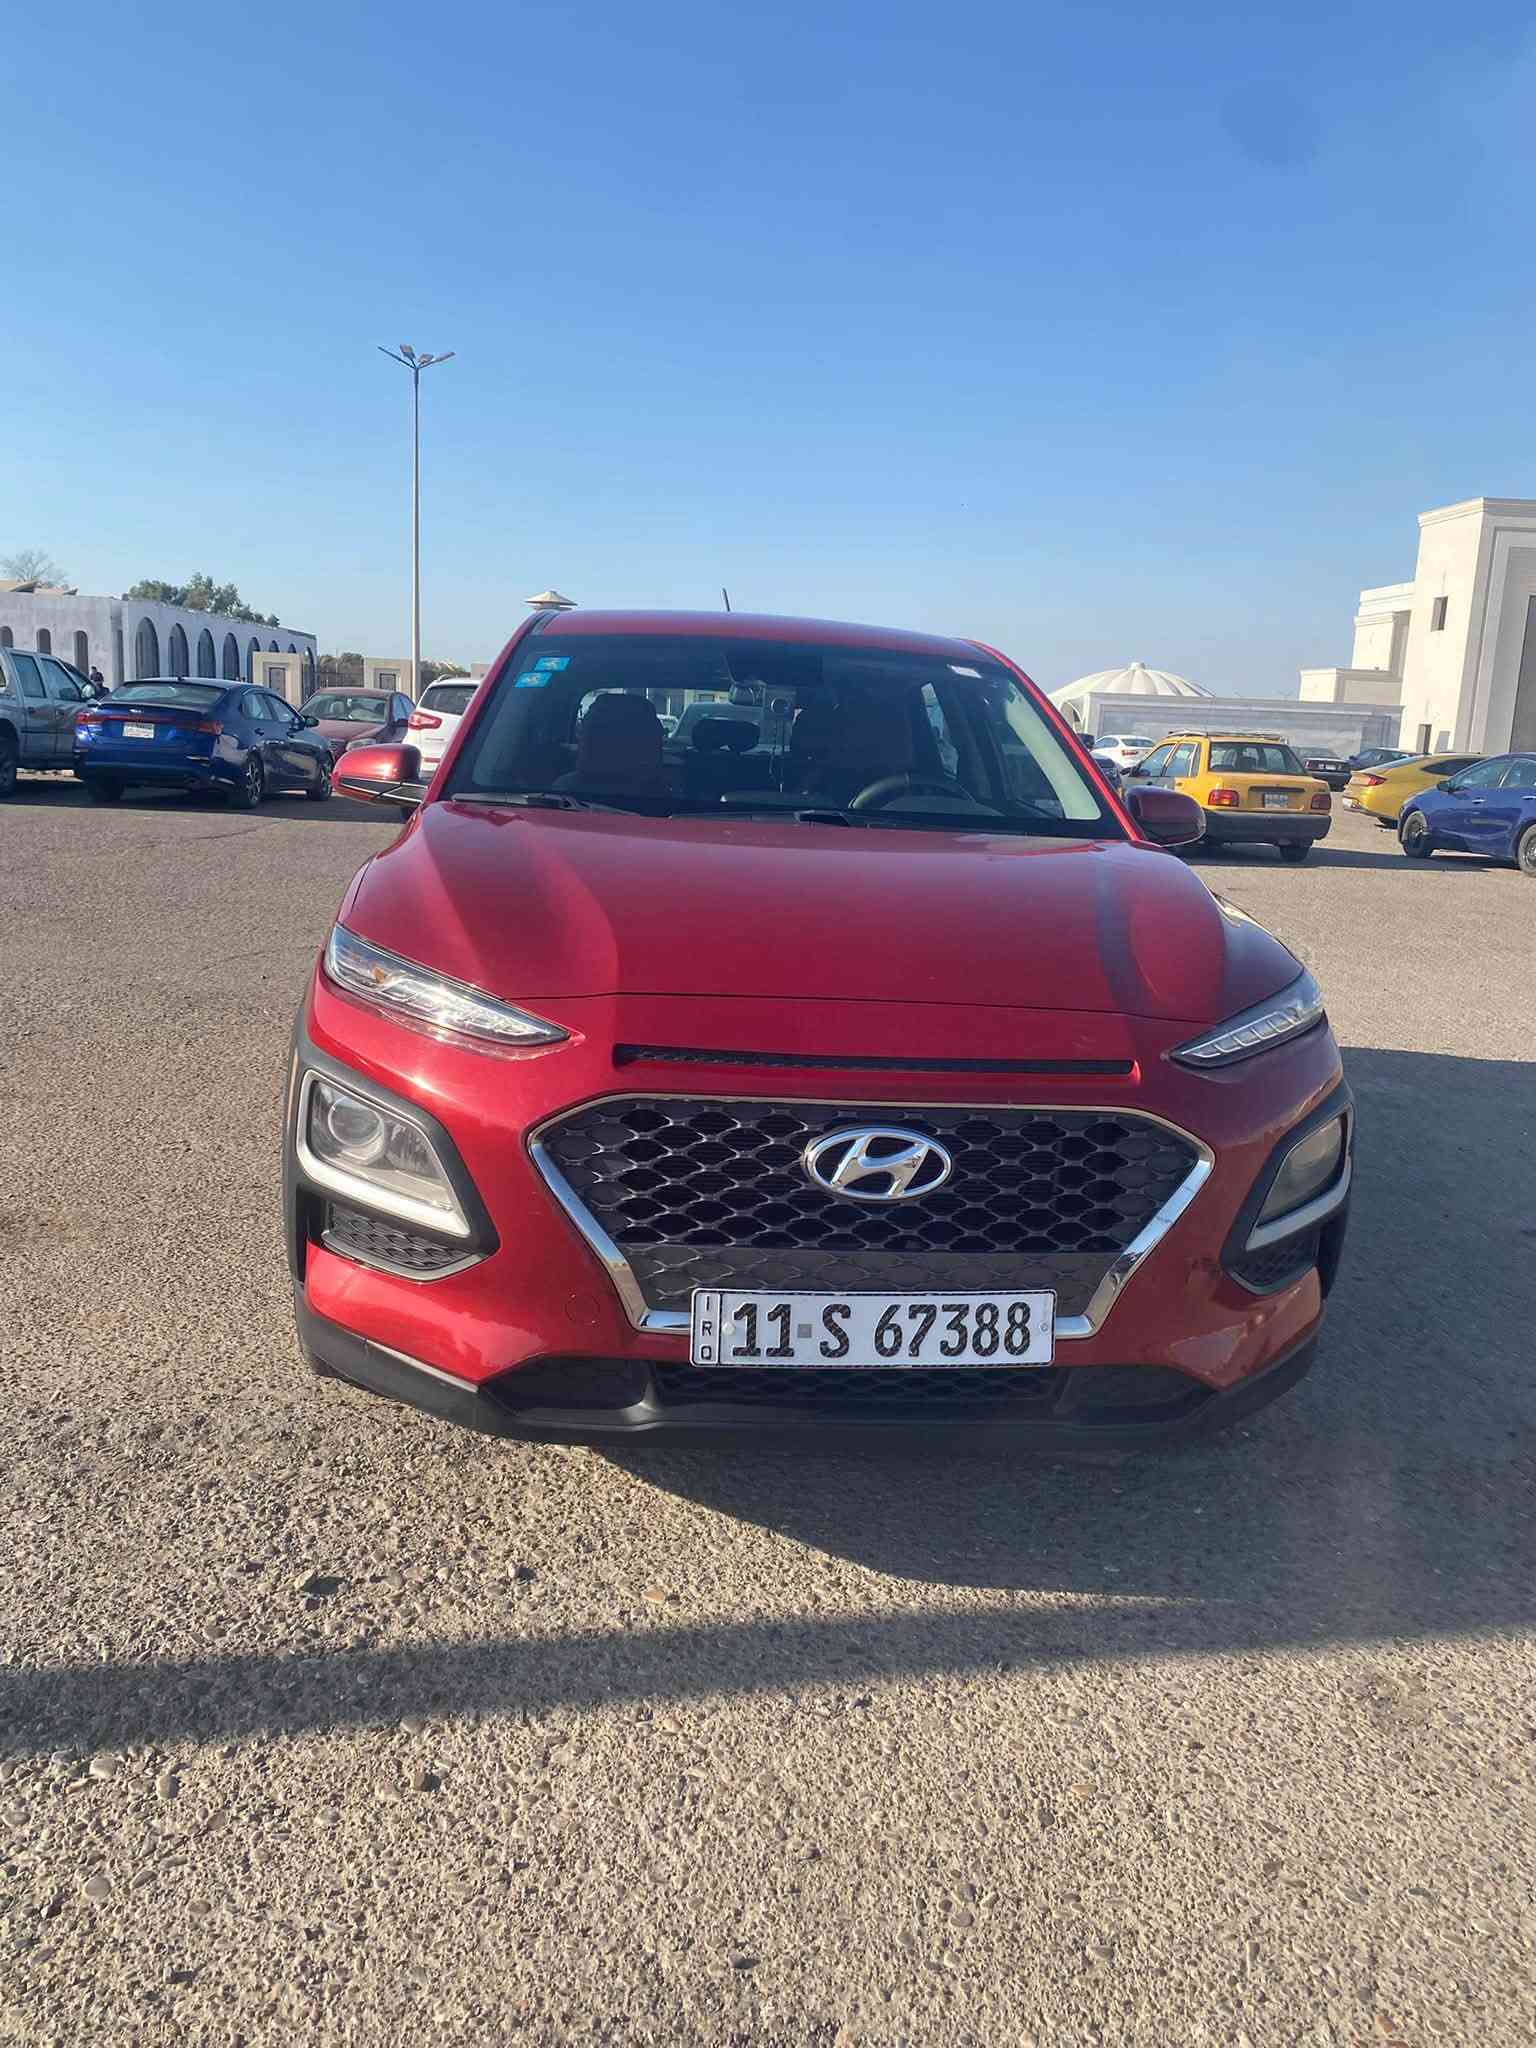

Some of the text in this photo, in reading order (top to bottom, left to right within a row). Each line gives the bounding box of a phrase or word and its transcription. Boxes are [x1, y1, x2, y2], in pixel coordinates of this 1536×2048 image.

[732, 1301, 1031, 1358] 11 S 67388
